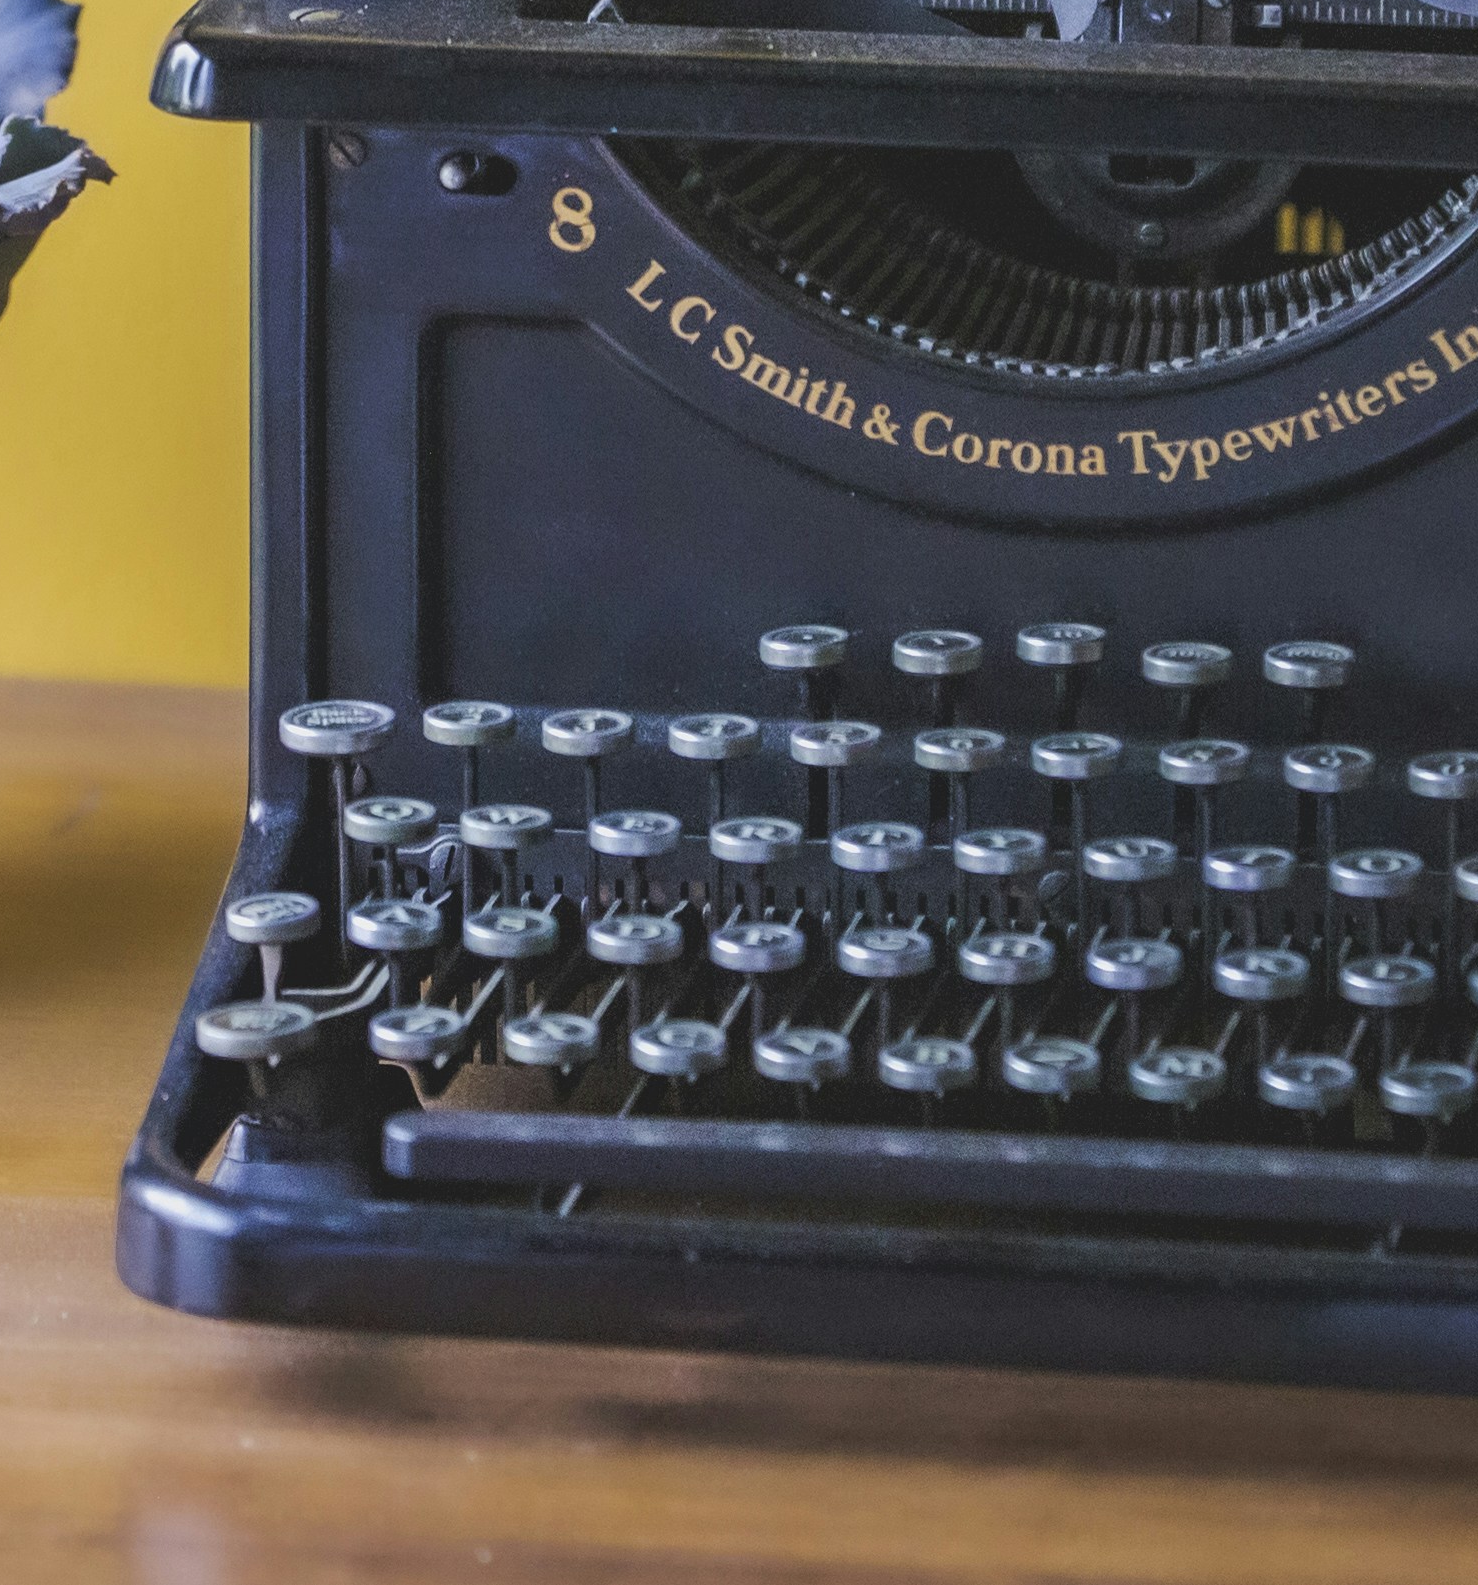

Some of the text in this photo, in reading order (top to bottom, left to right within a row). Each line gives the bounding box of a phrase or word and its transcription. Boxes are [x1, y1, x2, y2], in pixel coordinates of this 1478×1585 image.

[548, 186, 597, 252] 8
[625, 259, 668, 313] L
[669, 295, 718, 346] C
[711, 323, 857, 430] Smith
[861, 403, 902, 446] &
[911, 410, 1109, 477] Corona
[1117, 358, 1439, 484] Typewriters
